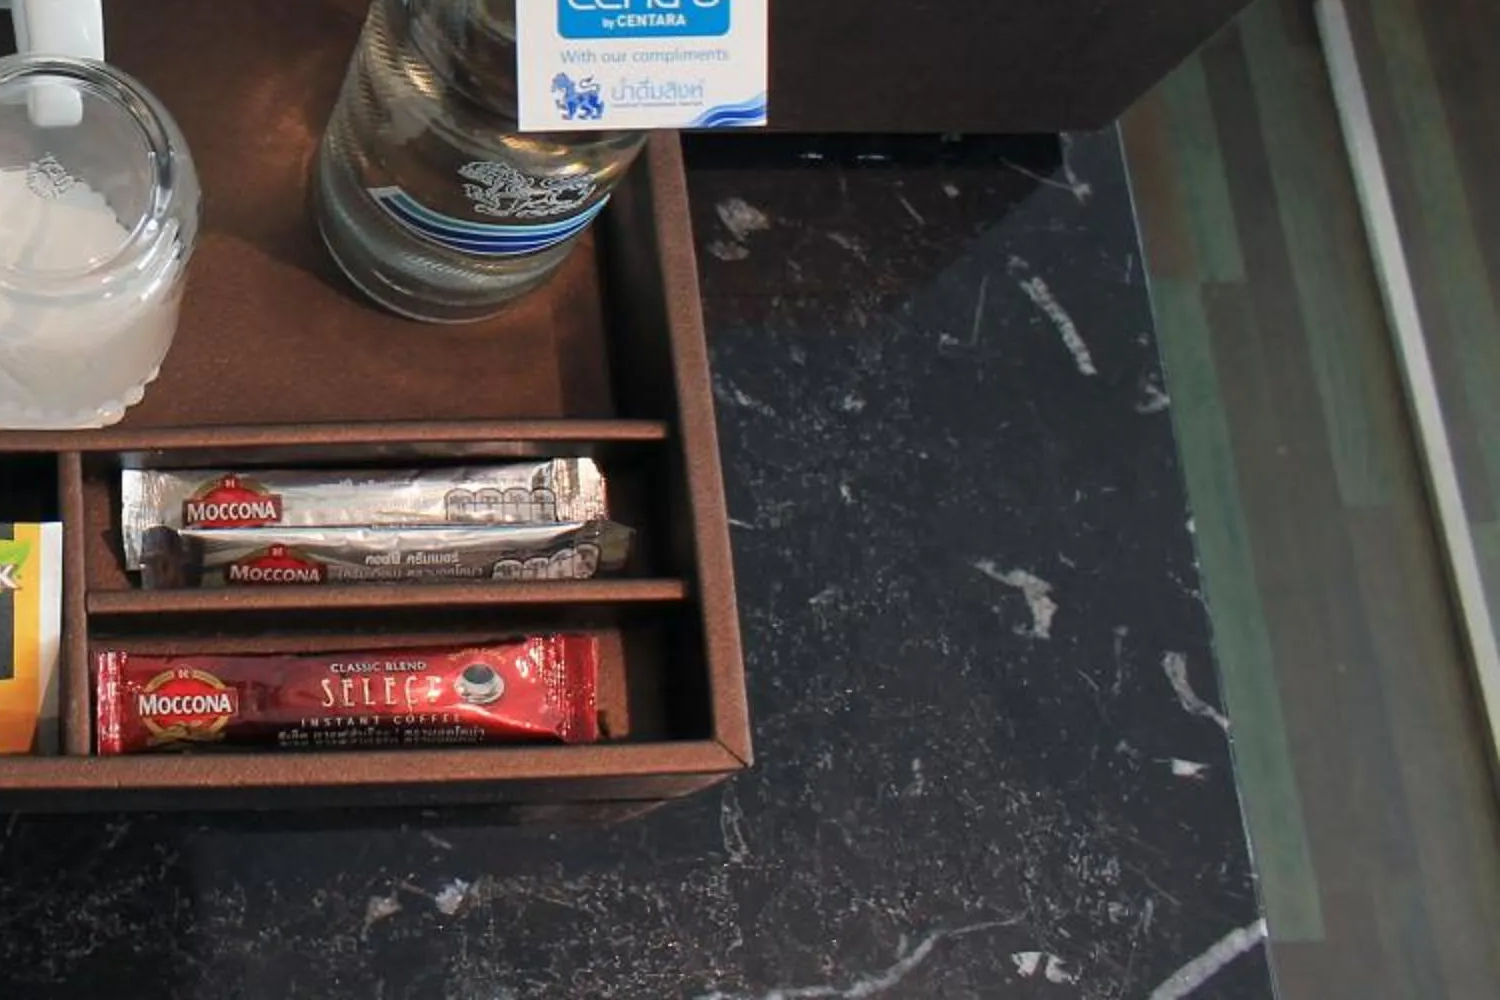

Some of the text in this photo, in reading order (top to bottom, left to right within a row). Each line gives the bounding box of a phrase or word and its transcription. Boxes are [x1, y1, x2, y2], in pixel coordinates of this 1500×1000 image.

[617, 13, 687, 28] CENTARA
[560, 47, 730, 64] With our compliments
[186, 500, 278, 523] MOCCONA
[230, 563, 321, 584] MOCCONA
[329, 660, 428, 673] CLASSIC BLEND
[320, 674, 443, 710] SELECT
[138, 693, 233, 716] MOCCONA
[301, 712, 462, 728] INSTANT COFFEE
